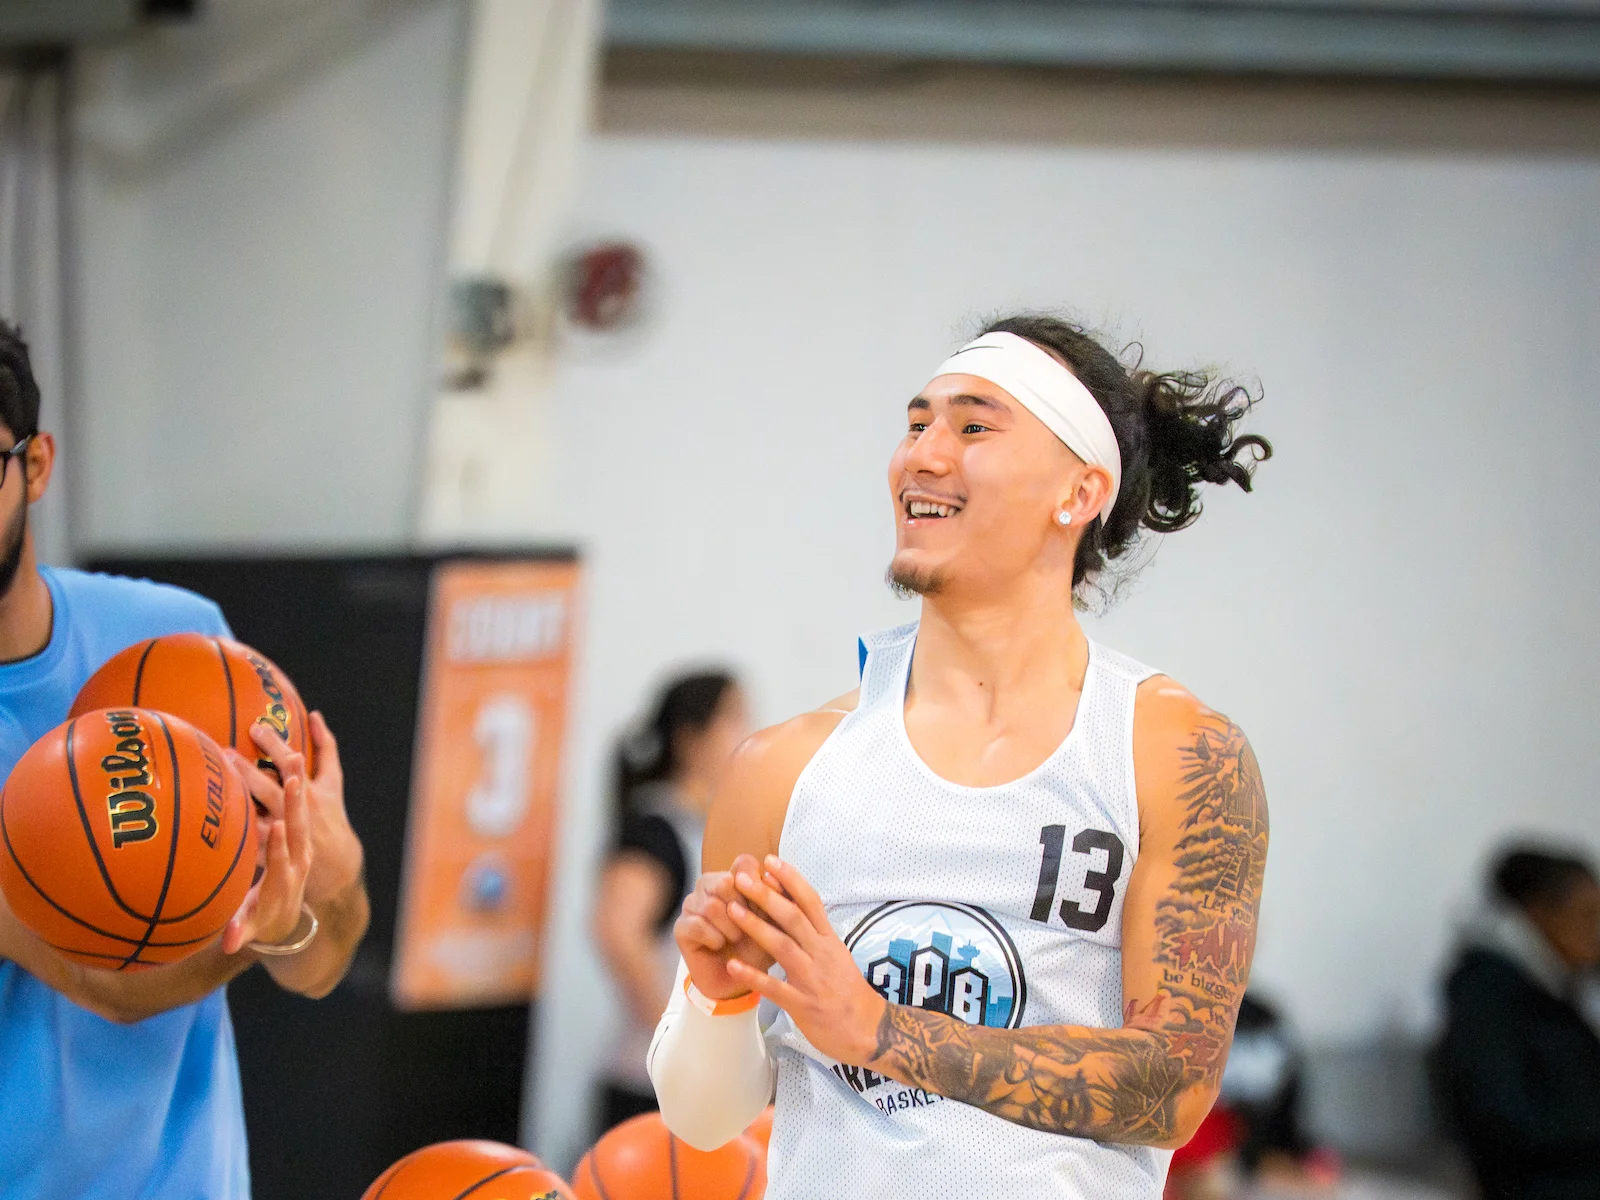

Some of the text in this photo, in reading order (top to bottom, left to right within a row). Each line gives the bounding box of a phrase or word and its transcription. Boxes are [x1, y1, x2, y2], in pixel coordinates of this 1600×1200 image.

[101, 710, 159, 849] Wilson
[463, 694, 536, 838] 3
[1030, 824, 1125, 933] 13
[867, 945, 989, 1026] 3PB
